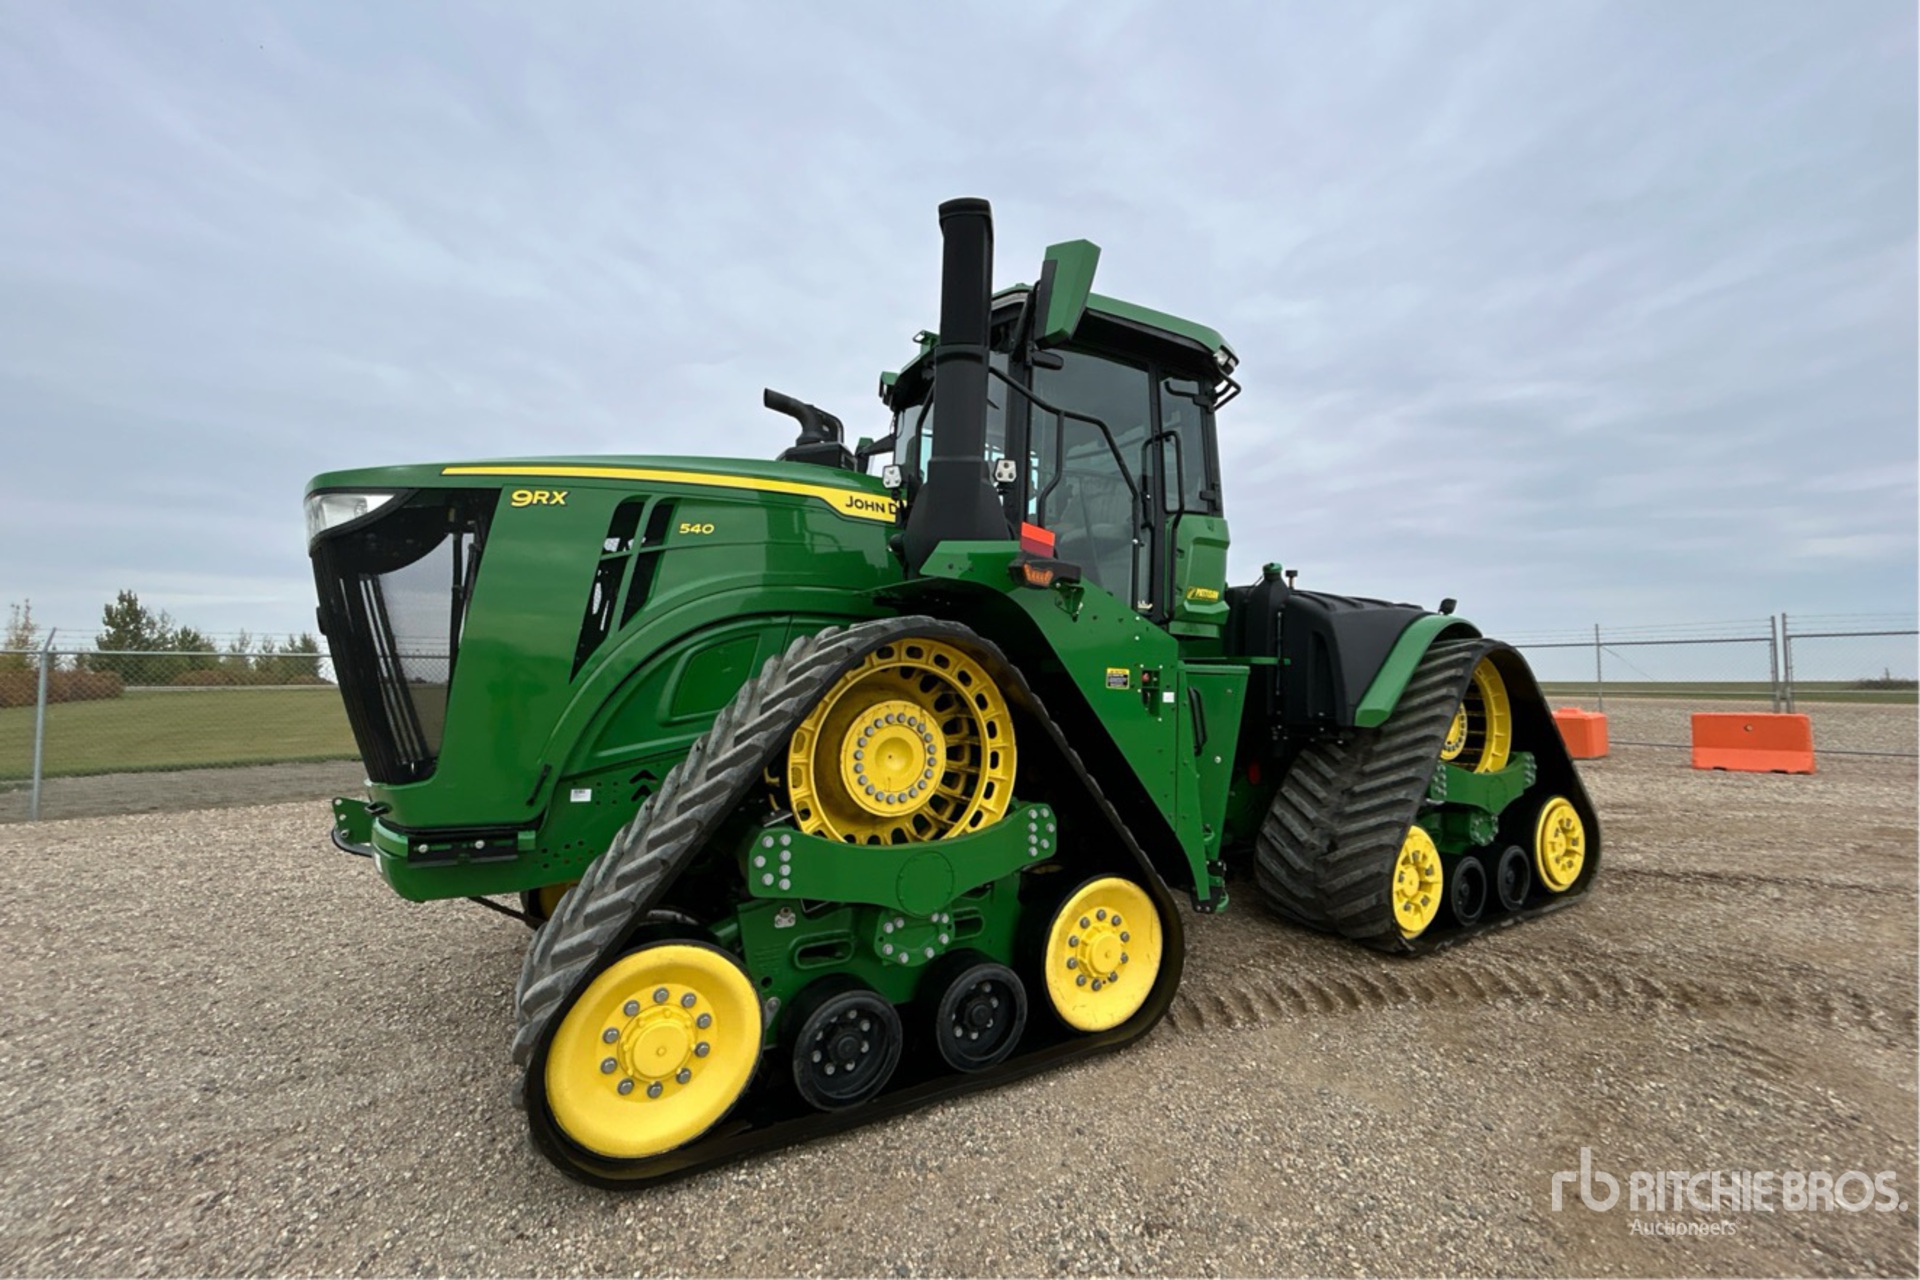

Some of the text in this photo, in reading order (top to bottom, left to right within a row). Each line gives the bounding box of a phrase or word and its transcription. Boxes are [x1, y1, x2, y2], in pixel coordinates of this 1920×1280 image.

[511, 489, 568, 507] 9RX
[845, 495, 885, 513] JOHN
[679, 523, 715, 534] 540
